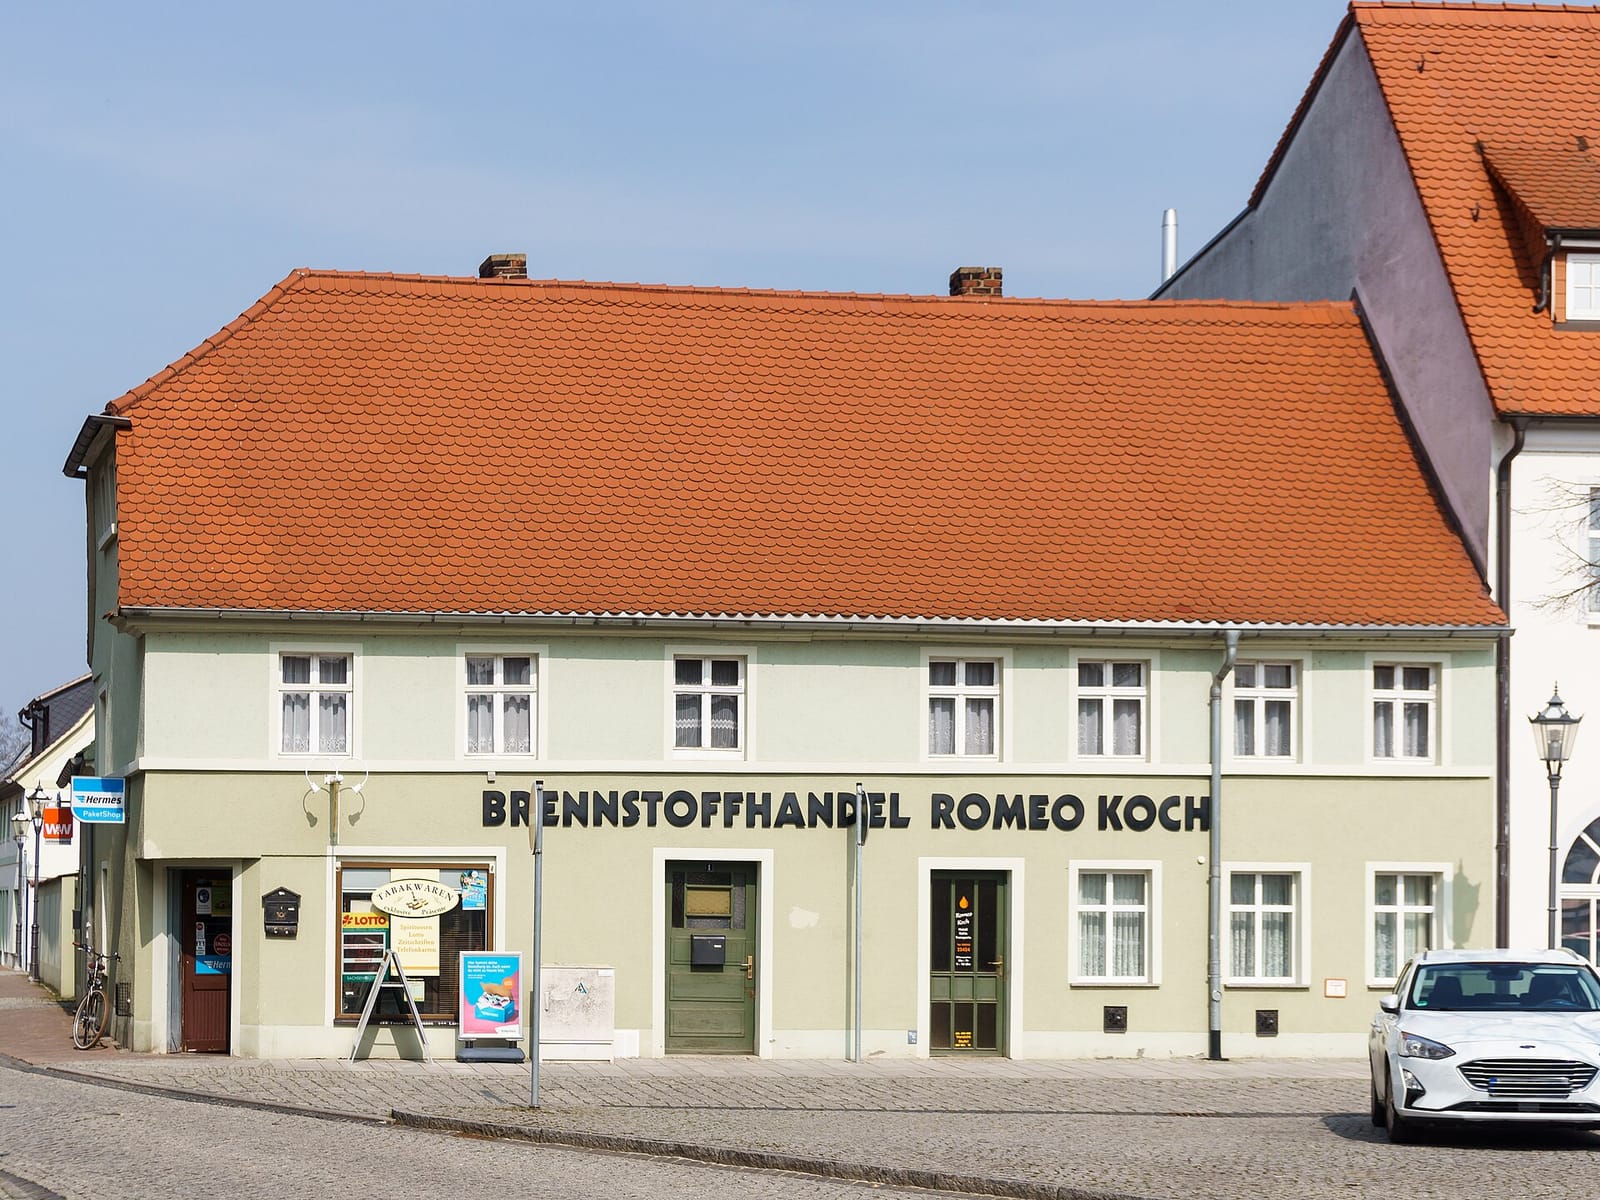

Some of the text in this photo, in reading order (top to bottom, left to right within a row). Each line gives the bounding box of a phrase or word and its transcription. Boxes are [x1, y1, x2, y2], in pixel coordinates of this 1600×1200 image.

[86, 795, 122, 805] Hermes
[83, 811, 121, 820] PaketShop
[482, 789, 1210, 832] BRENNSTOFFHANDEL ROMEO KOCH
[377, 884, 454, 902] TABAKWAREN
[355, 916, 387, 925] LOTTO
